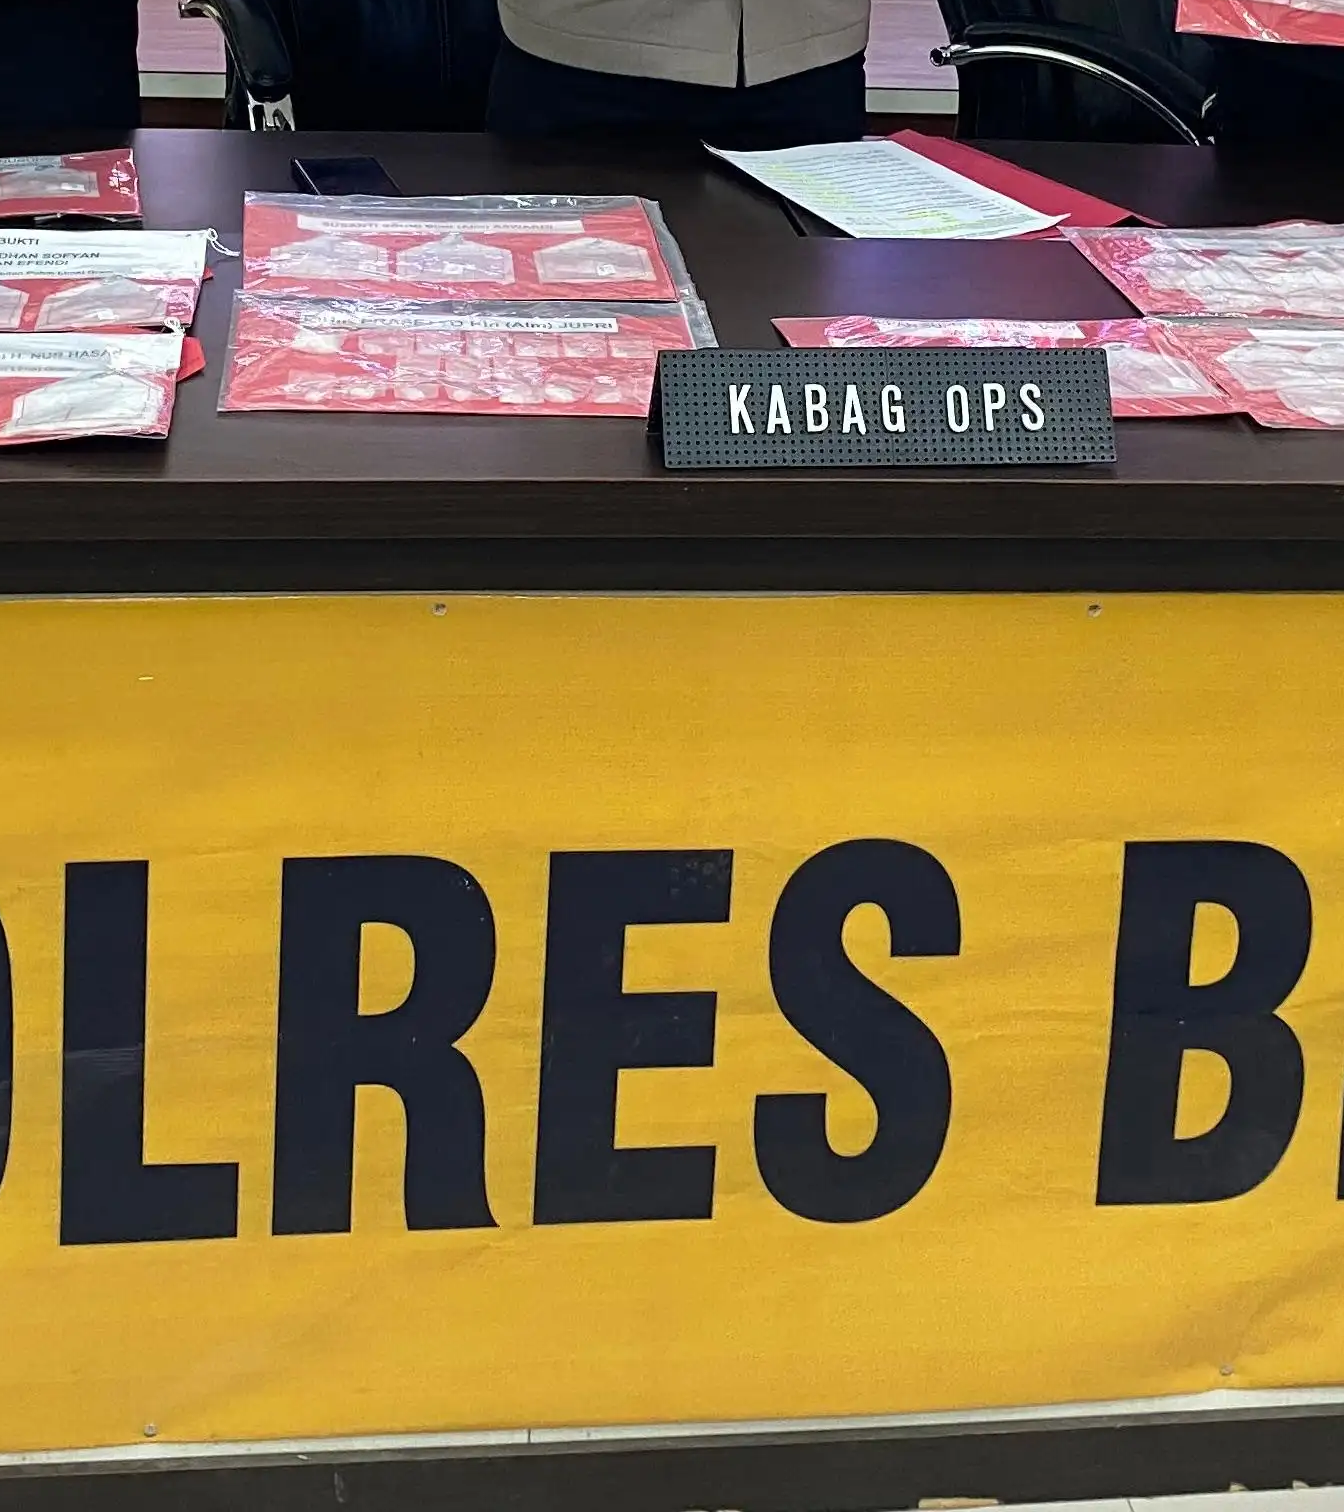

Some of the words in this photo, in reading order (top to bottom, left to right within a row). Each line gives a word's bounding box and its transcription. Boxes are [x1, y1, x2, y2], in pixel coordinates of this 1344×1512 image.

[41, 251, 102, 259] SOFYAN
[558, 321, 614, 330] JUPRI
[728, 383, 906, 435] KABAG
[946, 383, 1046, 433] OPS
